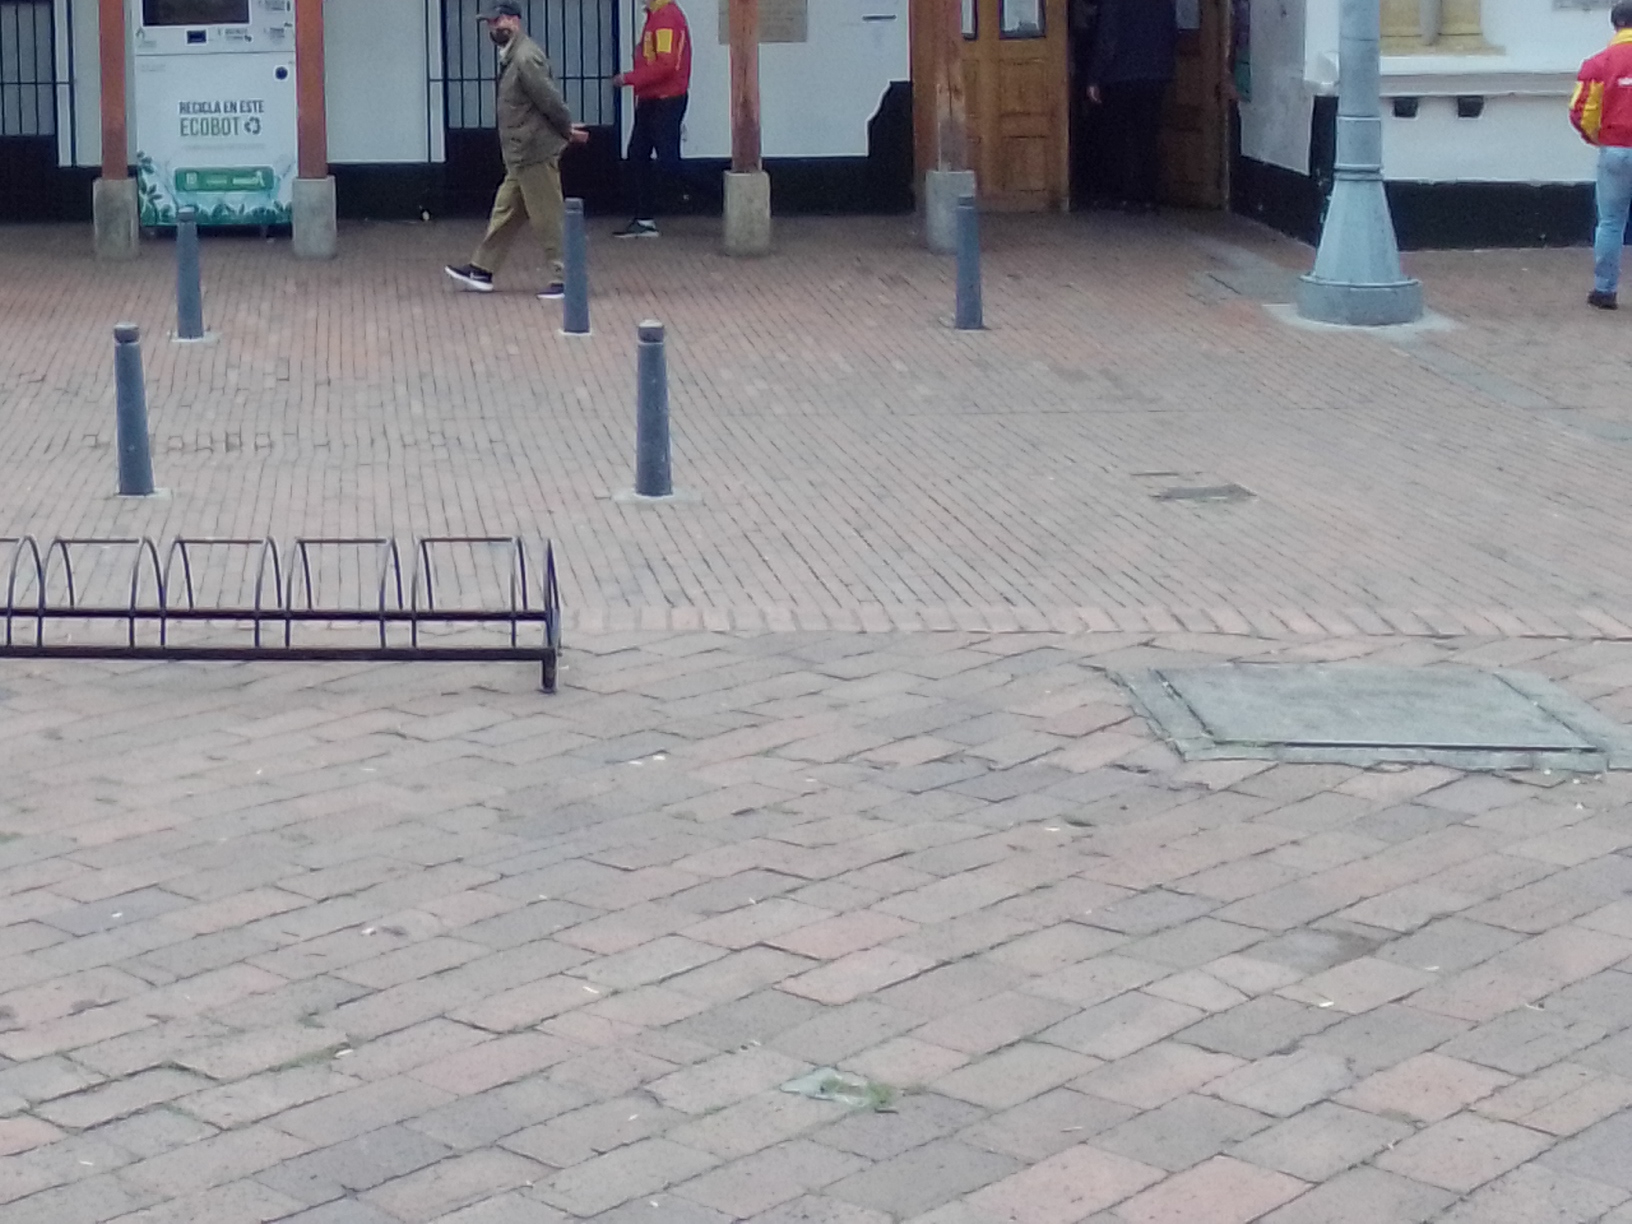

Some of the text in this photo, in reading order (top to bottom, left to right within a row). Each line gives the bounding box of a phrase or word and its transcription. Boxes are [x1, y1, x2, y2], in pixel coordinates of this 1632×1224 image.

[179, 99, 264, 114] RECICLA EN ESTE
[180, 117, 240, 136] ECOBOT
